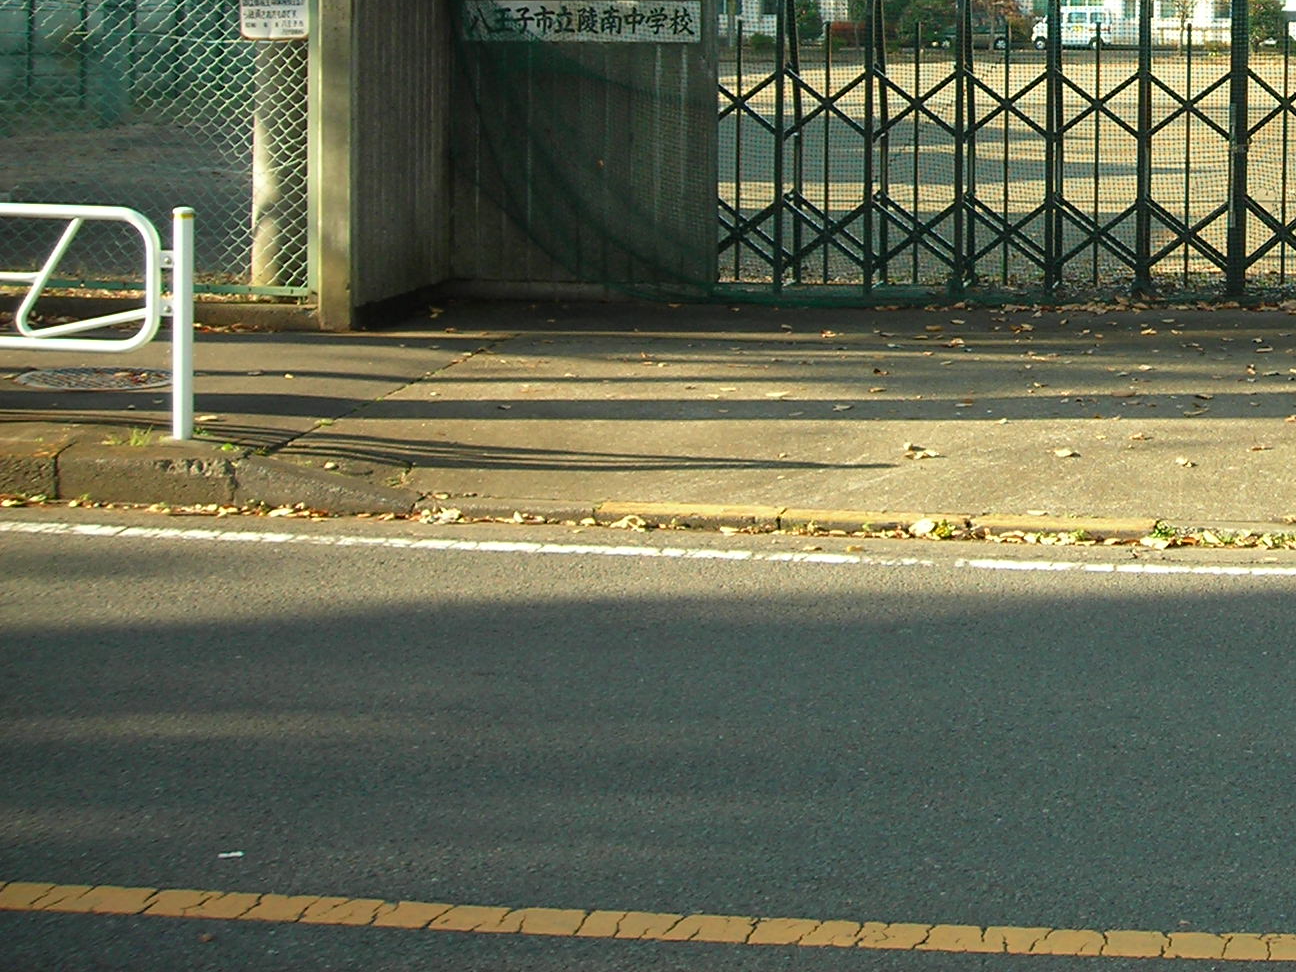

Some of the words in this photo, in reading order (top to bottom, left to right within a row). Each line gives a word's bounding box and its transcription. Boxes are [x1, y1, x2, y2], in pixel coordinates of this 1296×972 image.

[467, 5, 695, 35] 八王子市立陵南中学校
